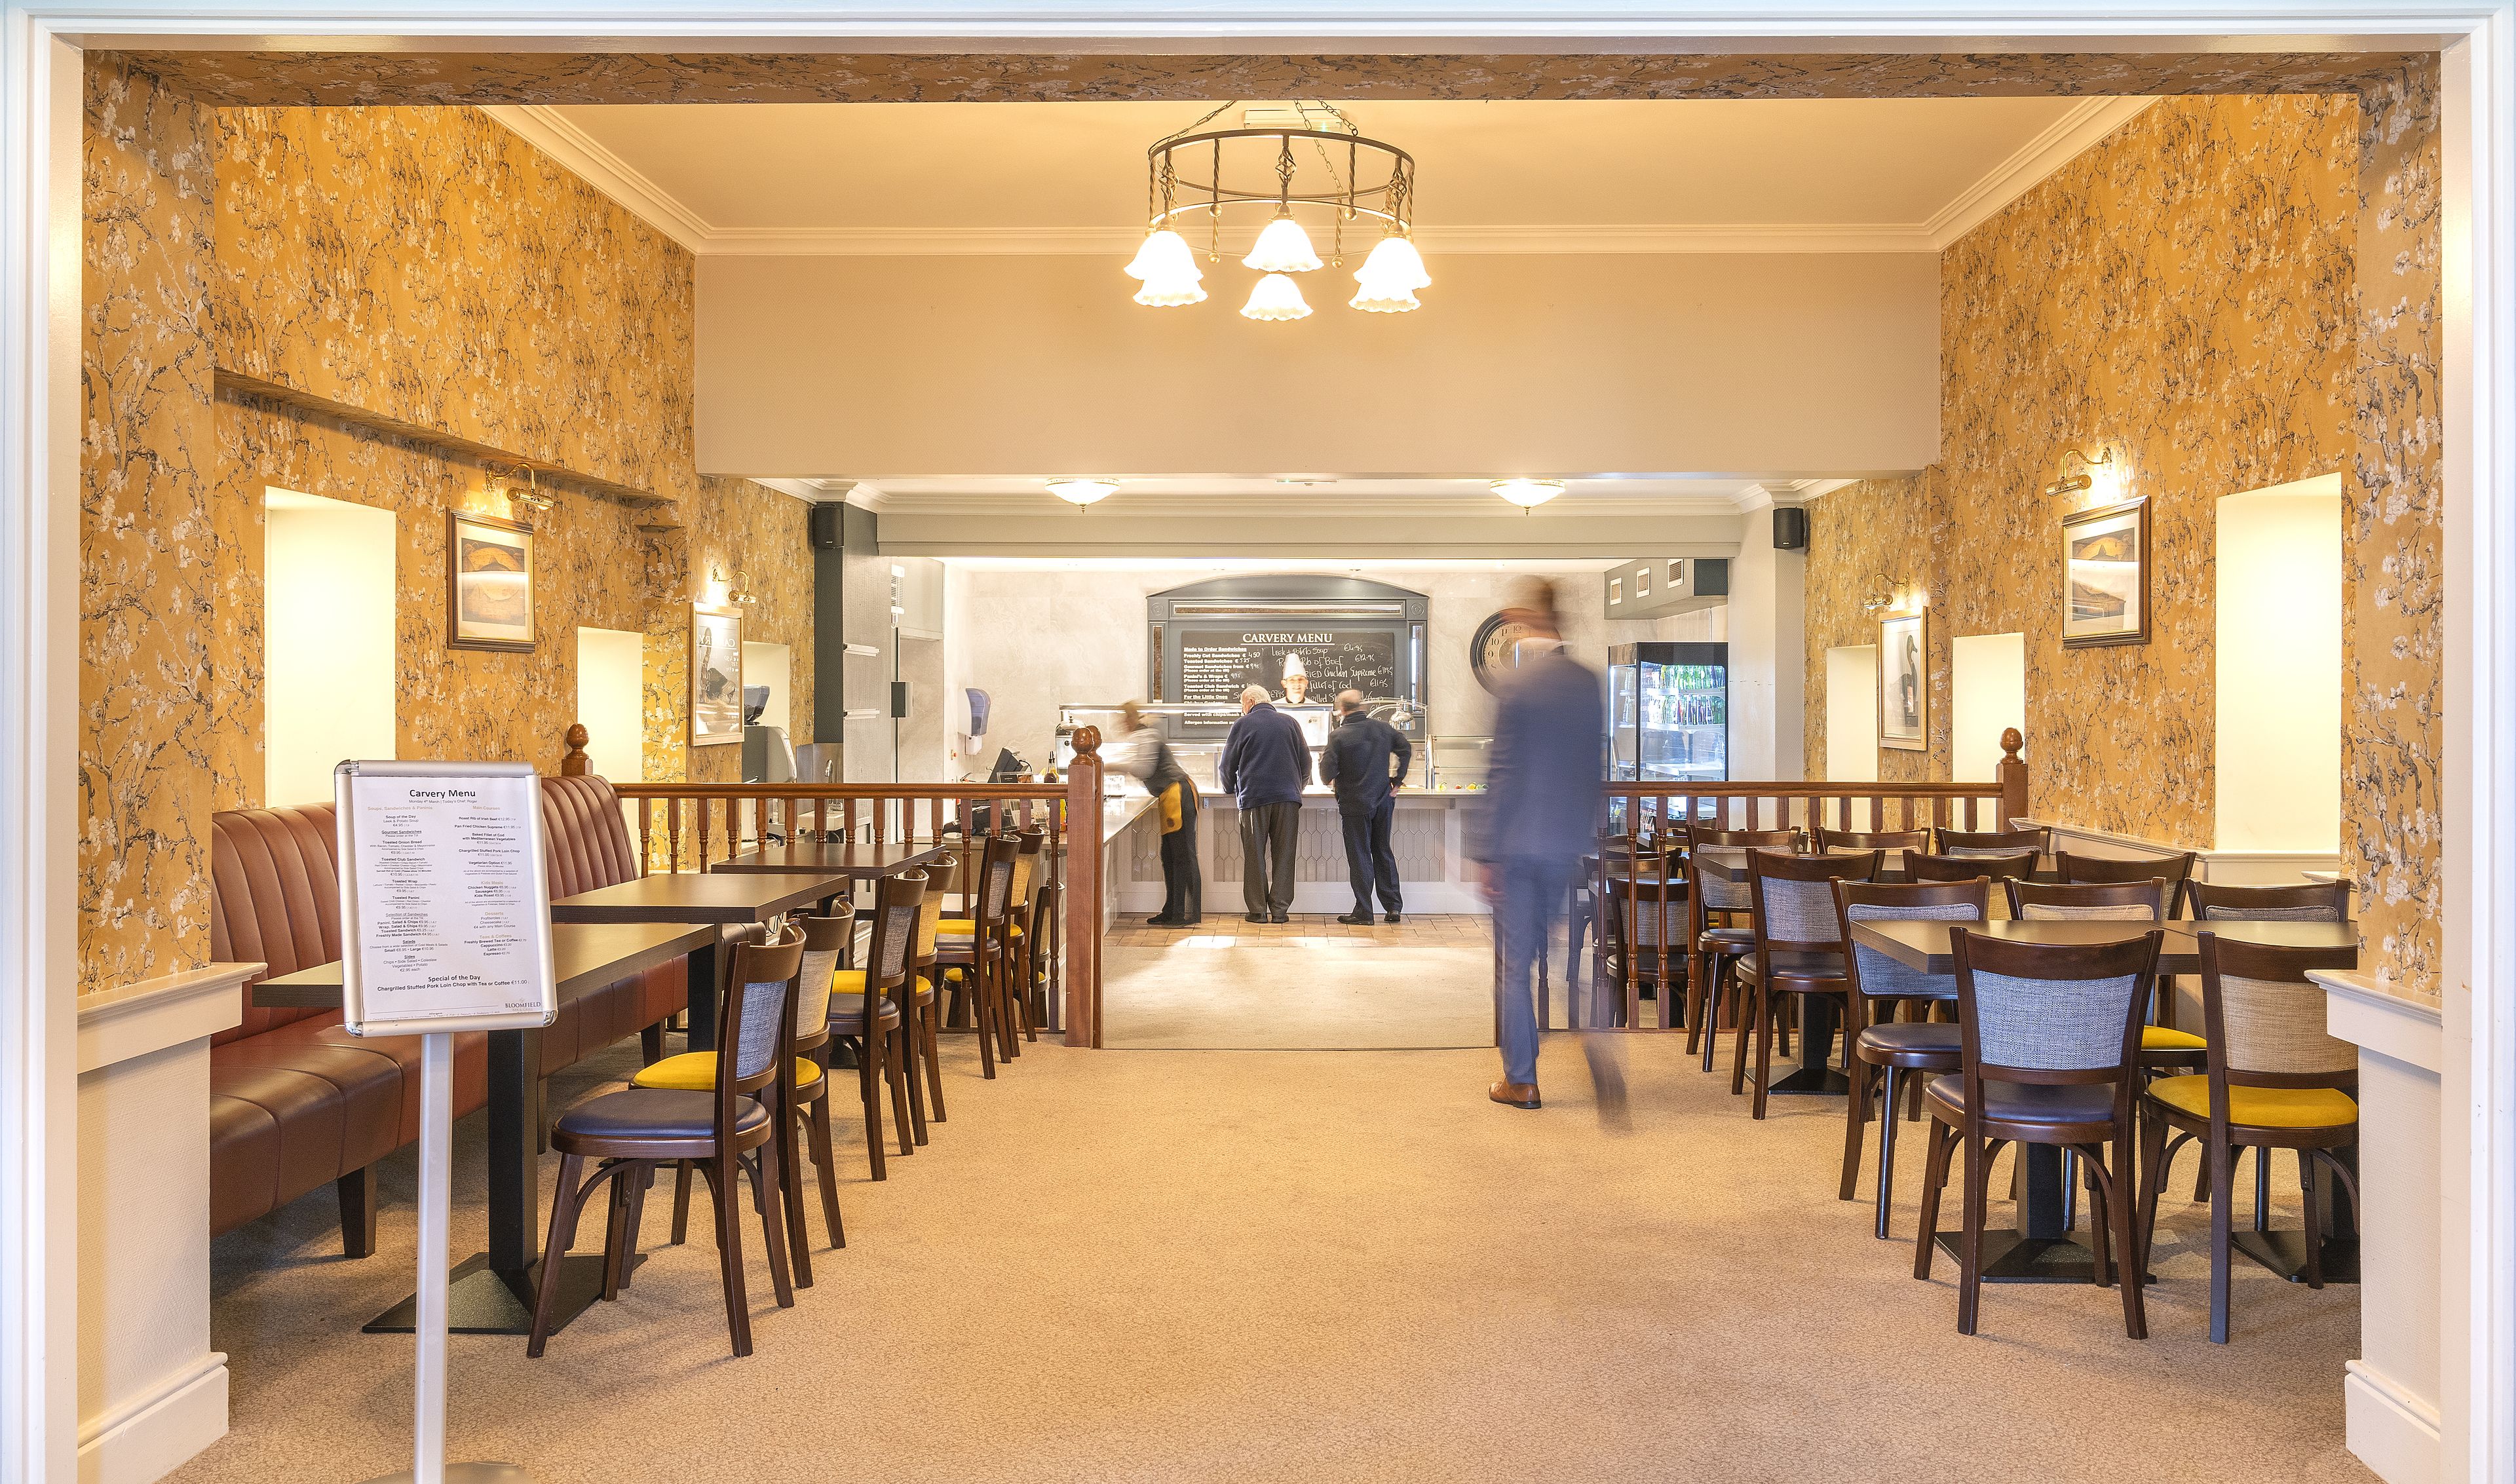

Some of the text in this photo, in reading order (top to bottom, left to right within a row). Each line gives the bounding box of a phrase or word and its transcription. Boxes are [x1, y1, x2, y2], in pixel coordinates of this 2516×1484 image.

[1242, 634, 1332, 643] CARVERY MENU
[410, 790, 446, 799] Carvery
